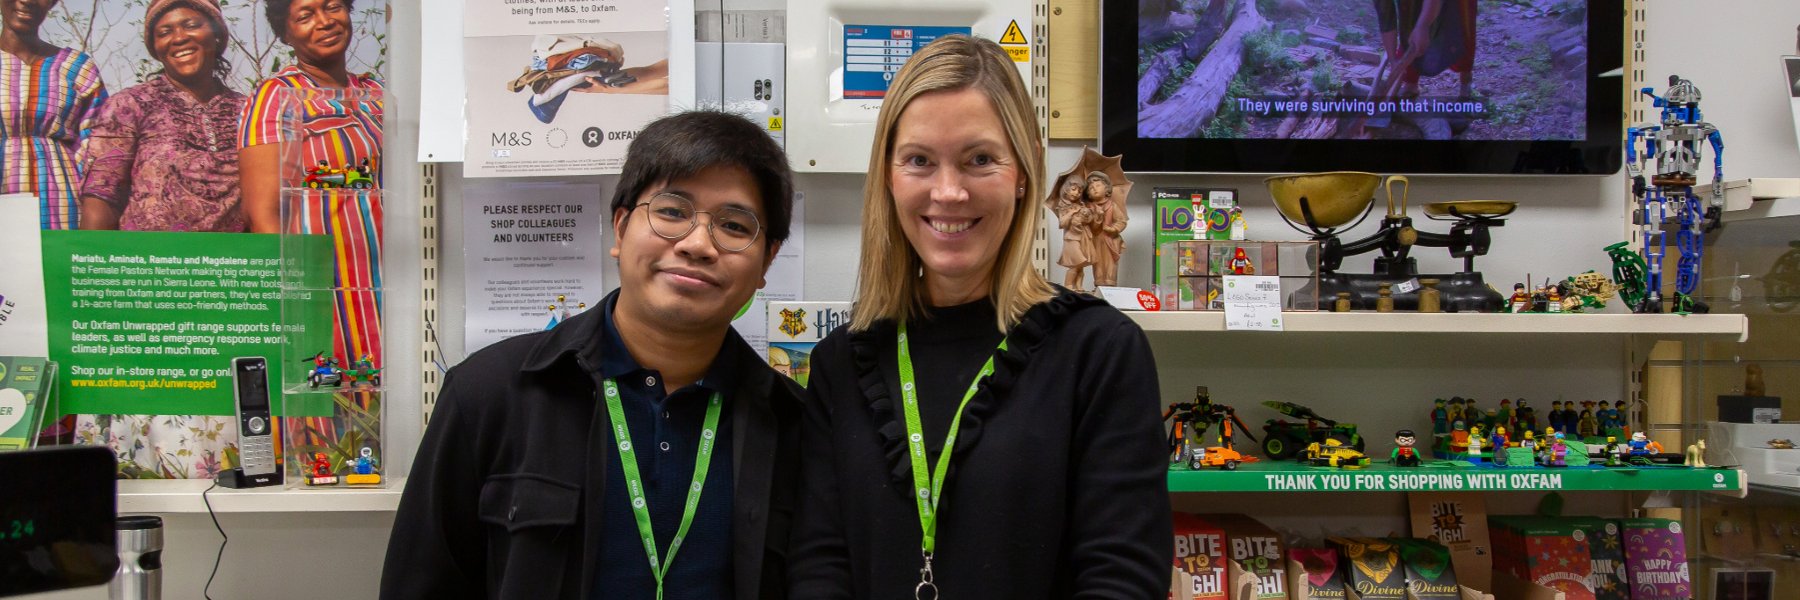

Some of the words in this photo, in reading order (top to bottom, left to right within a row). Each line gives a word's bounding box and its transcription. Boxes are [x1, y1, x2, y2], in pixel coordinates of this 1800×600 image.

[512, 8, 534, 16] being
[1238, 98, 1270, 115] They
[1274, 101, 1308, 112] were
[1312, 98, 1374, 115] surviving
[1379, 102, 1395, 112] on
[1400, 98, 1428, 112] that
[1432, 98, 1487, 112] income.
[491, 132, 532, 147] M&S
[483, 205, 518, 215] PLEASE
[521, 204, 562, 214] RESPECT
[565, 204, 583, 213] OUR
[491, 219, 515, 229] SHOP
[518, 218, 576, 228] COLLEAGUES
[1162, 207, 1230, 232] LOO
[494, 233, 512, 243] AND
[515, 233, 574, 242] VOLUNTEERS
[72, 254, 106, 263] Mariatu,
[109, 255, 147, 264] Aminata,
[149, 255, 182, 264] Ramatu
[184, 256, 200, 264] and
[202, 256, 248, 266] Magdalene
[72, 266, 86, 274] the
[88, 266, 119, 275] Female
[121, 266, 153, 275] Pastors
[155, 267, 190, 275] Network
[192, 268, 222, 278] making
[224, 268, 237, 278] big
[239, 268, 275, 278] changes
[72, 277, 120, 285] businesses
[154, 278, 162, 286] in
[164, 278, 188, 286] Sierra
[190, 278, 217, 287] Leone.
[220, 279, 239, 287] With
[261, 280, 281, 288] tools
[72, 288, 104, 299] training
[106, 289, 125, 297] from
[126, 289, 153, 297] Oxfam
[189, 290, 227, 300] partners,
[230, 290, 260, 300] they've
[80, 300, 112, 308] 14-acre
[113, 300, 133, 308] farm
[135, 300, 152, 309] that
[177, 301, 228, 311] eco-friendly
[230, 302, 269, 311] methods.
[72, 320, 88, 330] Our
[90, 320, 120, 330] Oxfam
[123, 321, 175, 332] Unwrapped
[178, 322, 194, 333] gift
[197, 324, 224, 333] range
[227, 323, 269, 333] supports
[813, 308, 849, 339] Har
[72, 332, 110, 342] leaders,
[127, 333, 146, 342] well
[162, 335, 215, 345] emergency
[217, 336, 261, 345] response
[71, 344, 107, 353] climate
[109, 344, 142, 356] justice
[144, 345, 162, 354] and
[164, 345, 191, 354] much
[72, 365, 95, 377] Shop
[116, 366, 155, 376] in-store
[157, 368, 186, 378] range,
[201, 369, 214, 378] go
[216, 368, 232, 376] onl
[71, 378, 216, 390] www.oxfam.org.uk/unwrapped
[1265, 474, 1317, 489] THANK
[1320, 474, 1351, 489] YOU
[1355, 474, 1385, 489] FOR
[1389, 474, 1463, 489] SHOPPING
[1470, 474, 1507, 489] WITH
[1510, 473, 1562, 489] OXFAM
[1432, 501, 1464, 516] BITE
[1174, 534, 1222, 557] BITE
[1232, 537, 1280, 560] BITE
[1591, 559, 1614, 573] ANK
[1643, 560, 1672, 570] HAPPY
[1178, 568, 1224, 594] GHT
[1637, 572, 1682, 584] BIRTHDAY
[1357, 580, 1404, 596] Divine
[1411, 579, 1458, 594] Divine
